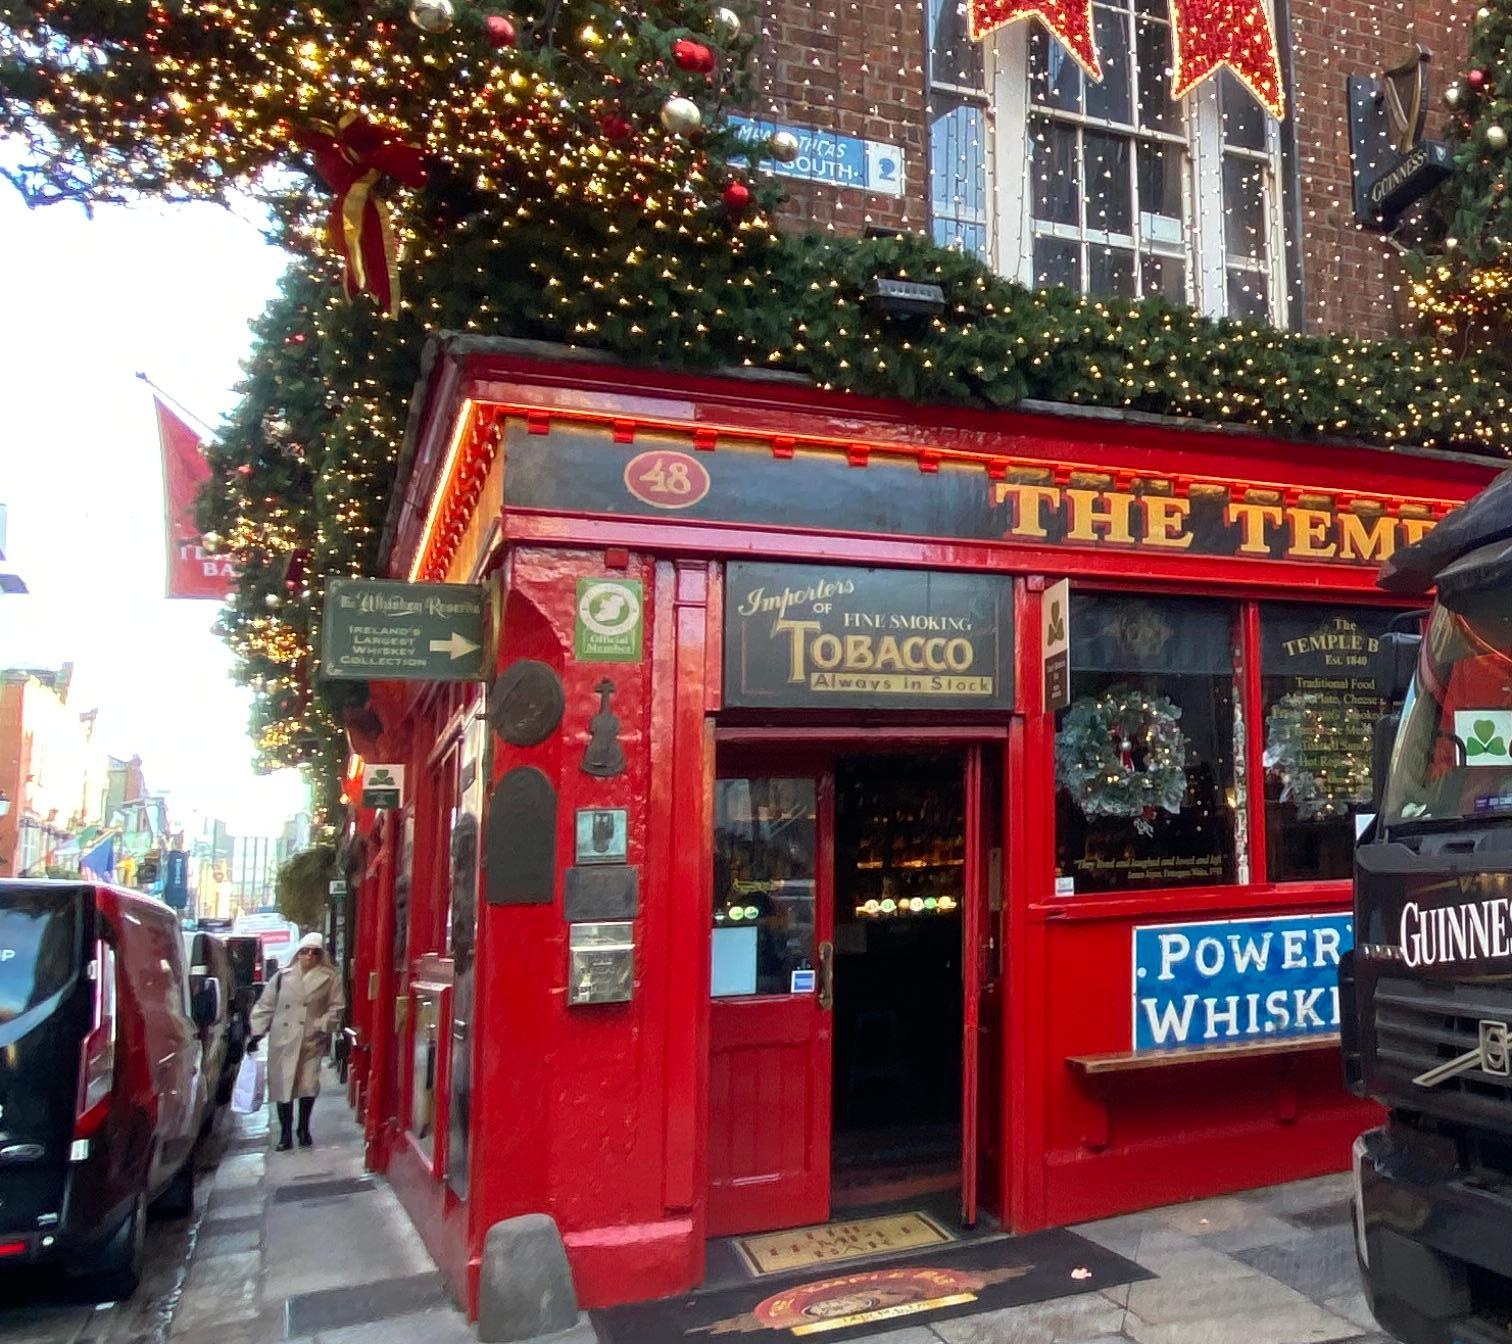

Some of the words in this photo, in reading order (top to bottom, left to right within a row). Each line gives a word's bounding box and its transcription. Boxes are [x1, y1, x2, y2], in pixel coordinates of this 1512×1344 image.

[879, 157, 897, 182] 2
[1371, 152, 1425, 202] GUINNESS
[639, 458, 692, 494] 48
[996, 483, 1195, 549] THE
[737, 578, 856, 618] Importers
[813, 602, 833, 615] OF
[350, 625, 422, 637] IRELAND'S
[844, 612, 886, 629] FINE
[890, 613, 973, 632] SMOKING
[1333, 617, 1357, 632] The
[352, 645, 416, 656] WHISKEY
[770, 617, 975, 685] TOBACCO
[1282, 633, 1363, 657] TEMPLE
[340, 656, 427, 668] COLLECTION
[814, 672, 892, 693] Always
[903, 676, 922, 691] in
[931, 674, 992, 693] Stock
[1295, 676, 1348, 690] Traditional
[1351, 677, 1376, 690] Food
